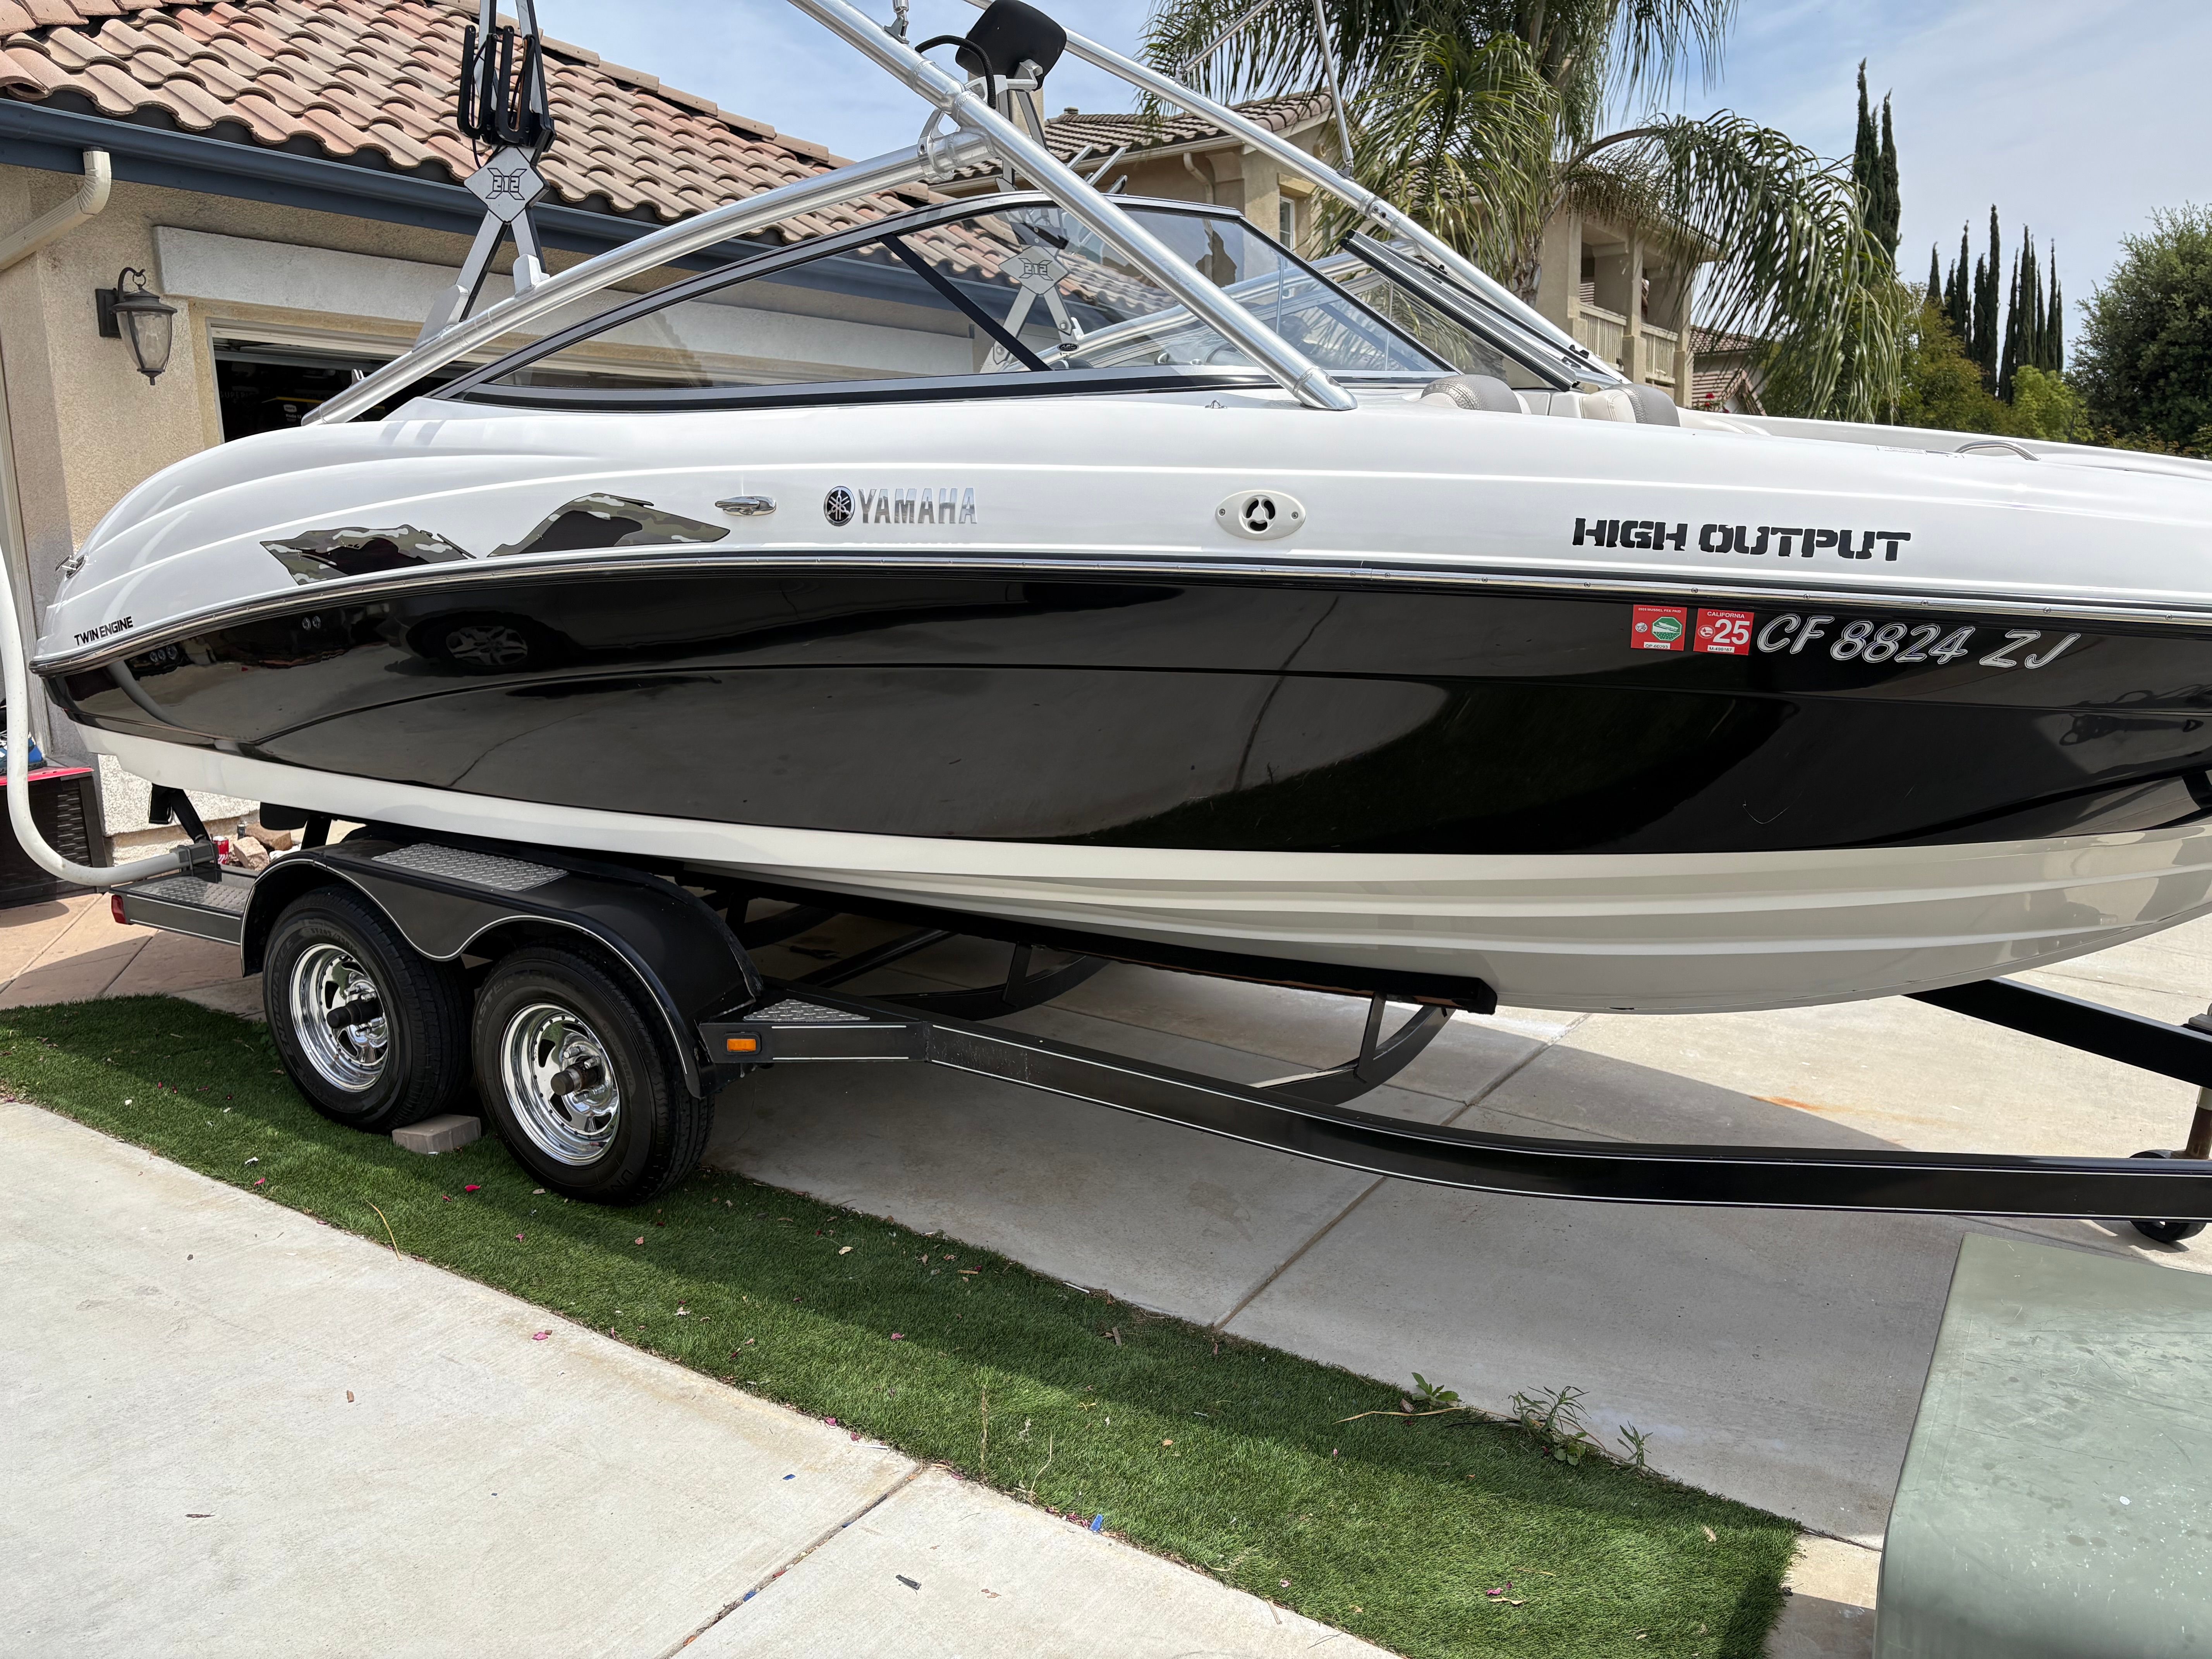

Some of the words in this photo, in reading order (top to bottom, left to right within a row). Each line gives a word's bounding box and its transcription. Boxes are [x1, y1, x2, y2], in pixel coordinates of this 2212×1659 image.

[858, 487, 977, 524] YAMAHA
[1572, 518, 1688, 551] HIGH
[1698, 524, 1911, 561] OUTPUT
[74, 627, 99, 646] TWIN
[99, 616, 133, 638] ENGINE
[1712, 619, 1750, 645] 25
[1757, 613, 1835, 654] CF
[1831, 620, 1976, 664] 8824
[1979, 630, 2081, 669] ZJ
